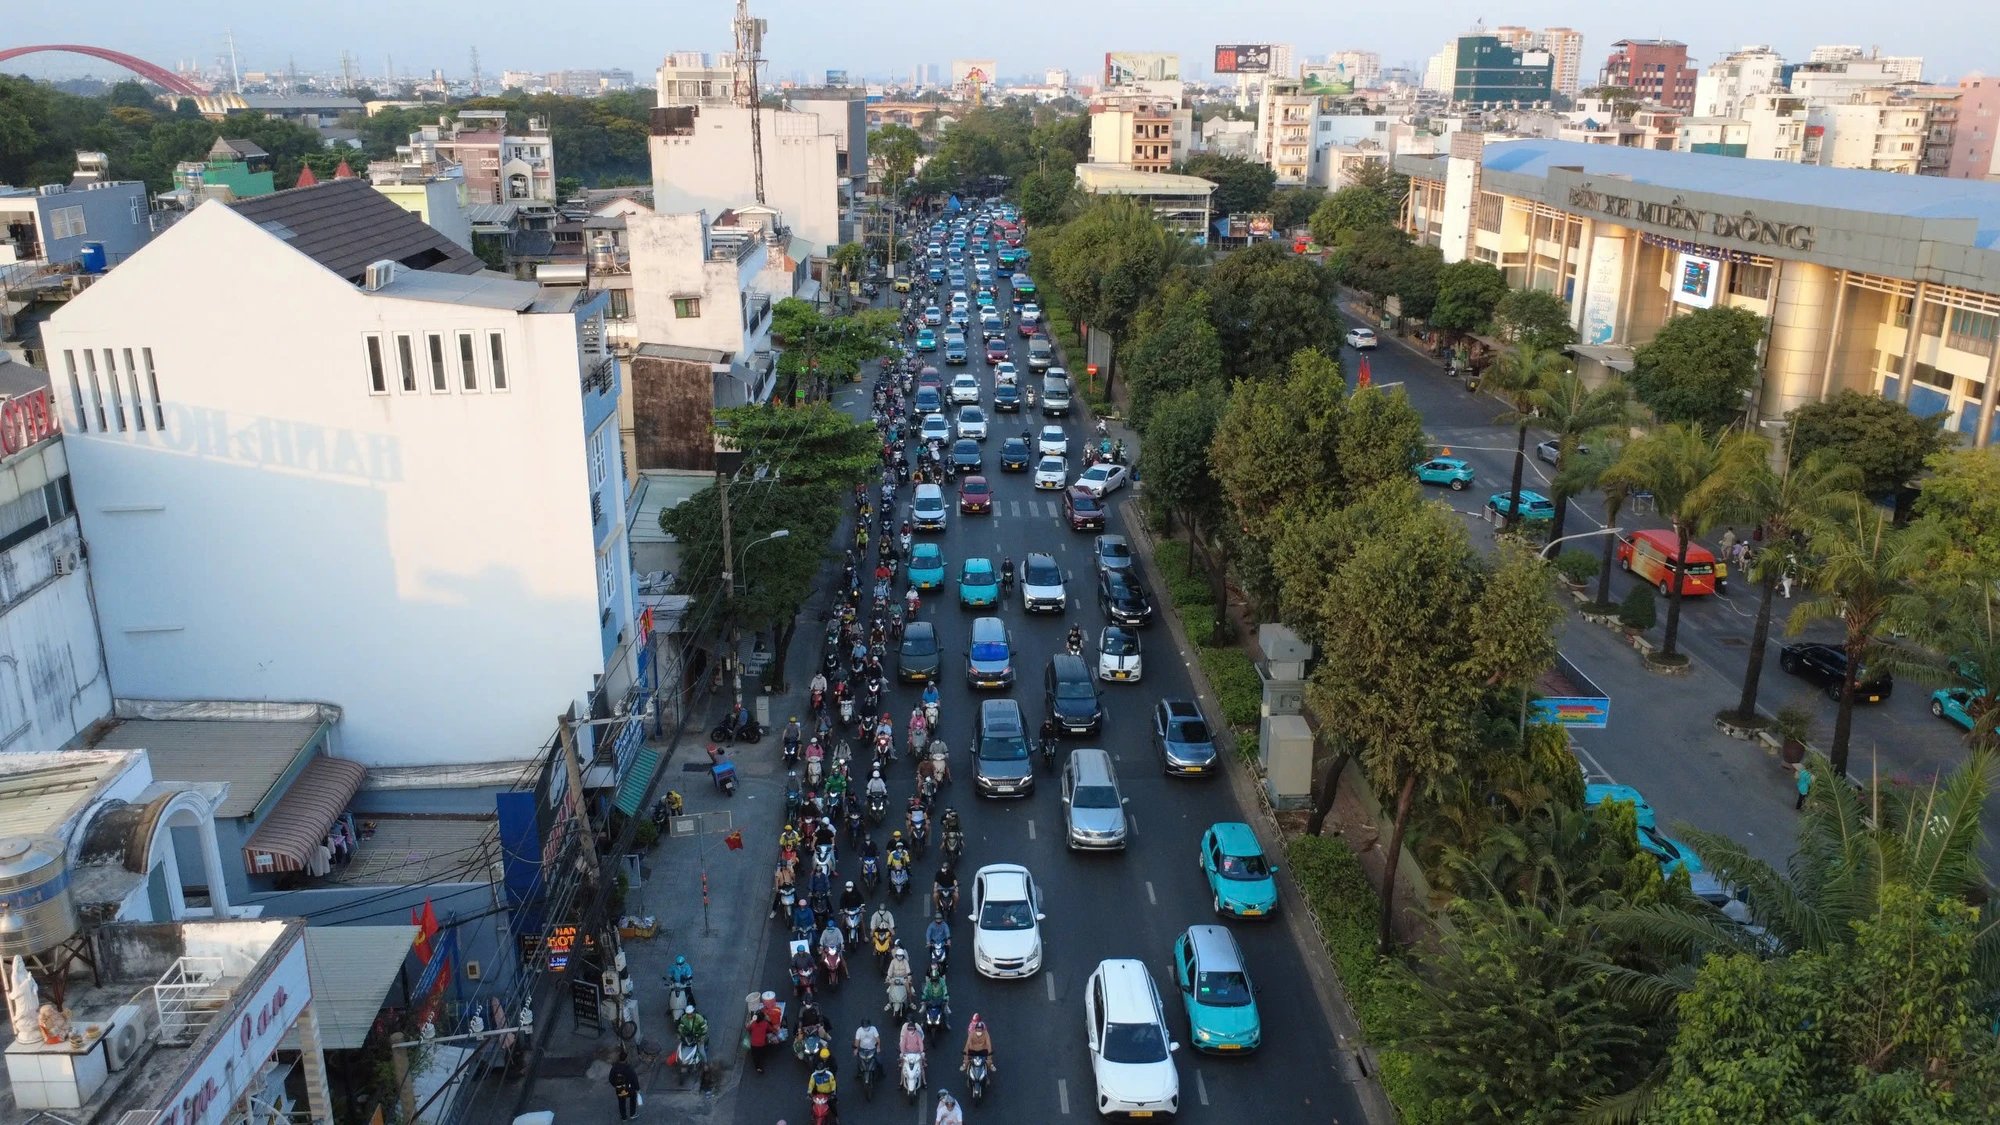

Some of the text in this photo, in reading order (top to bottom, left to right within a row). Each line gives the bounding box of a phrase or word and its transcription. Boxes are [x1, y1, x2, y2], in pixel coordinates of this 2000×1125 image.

[1603, 194, 1632, 219] XE
[1636, 194, 1706, 233] MIỀN
[1713, 209, 1816, 252] ĐÔNG
[547, 935, 594, 946] HOTL
